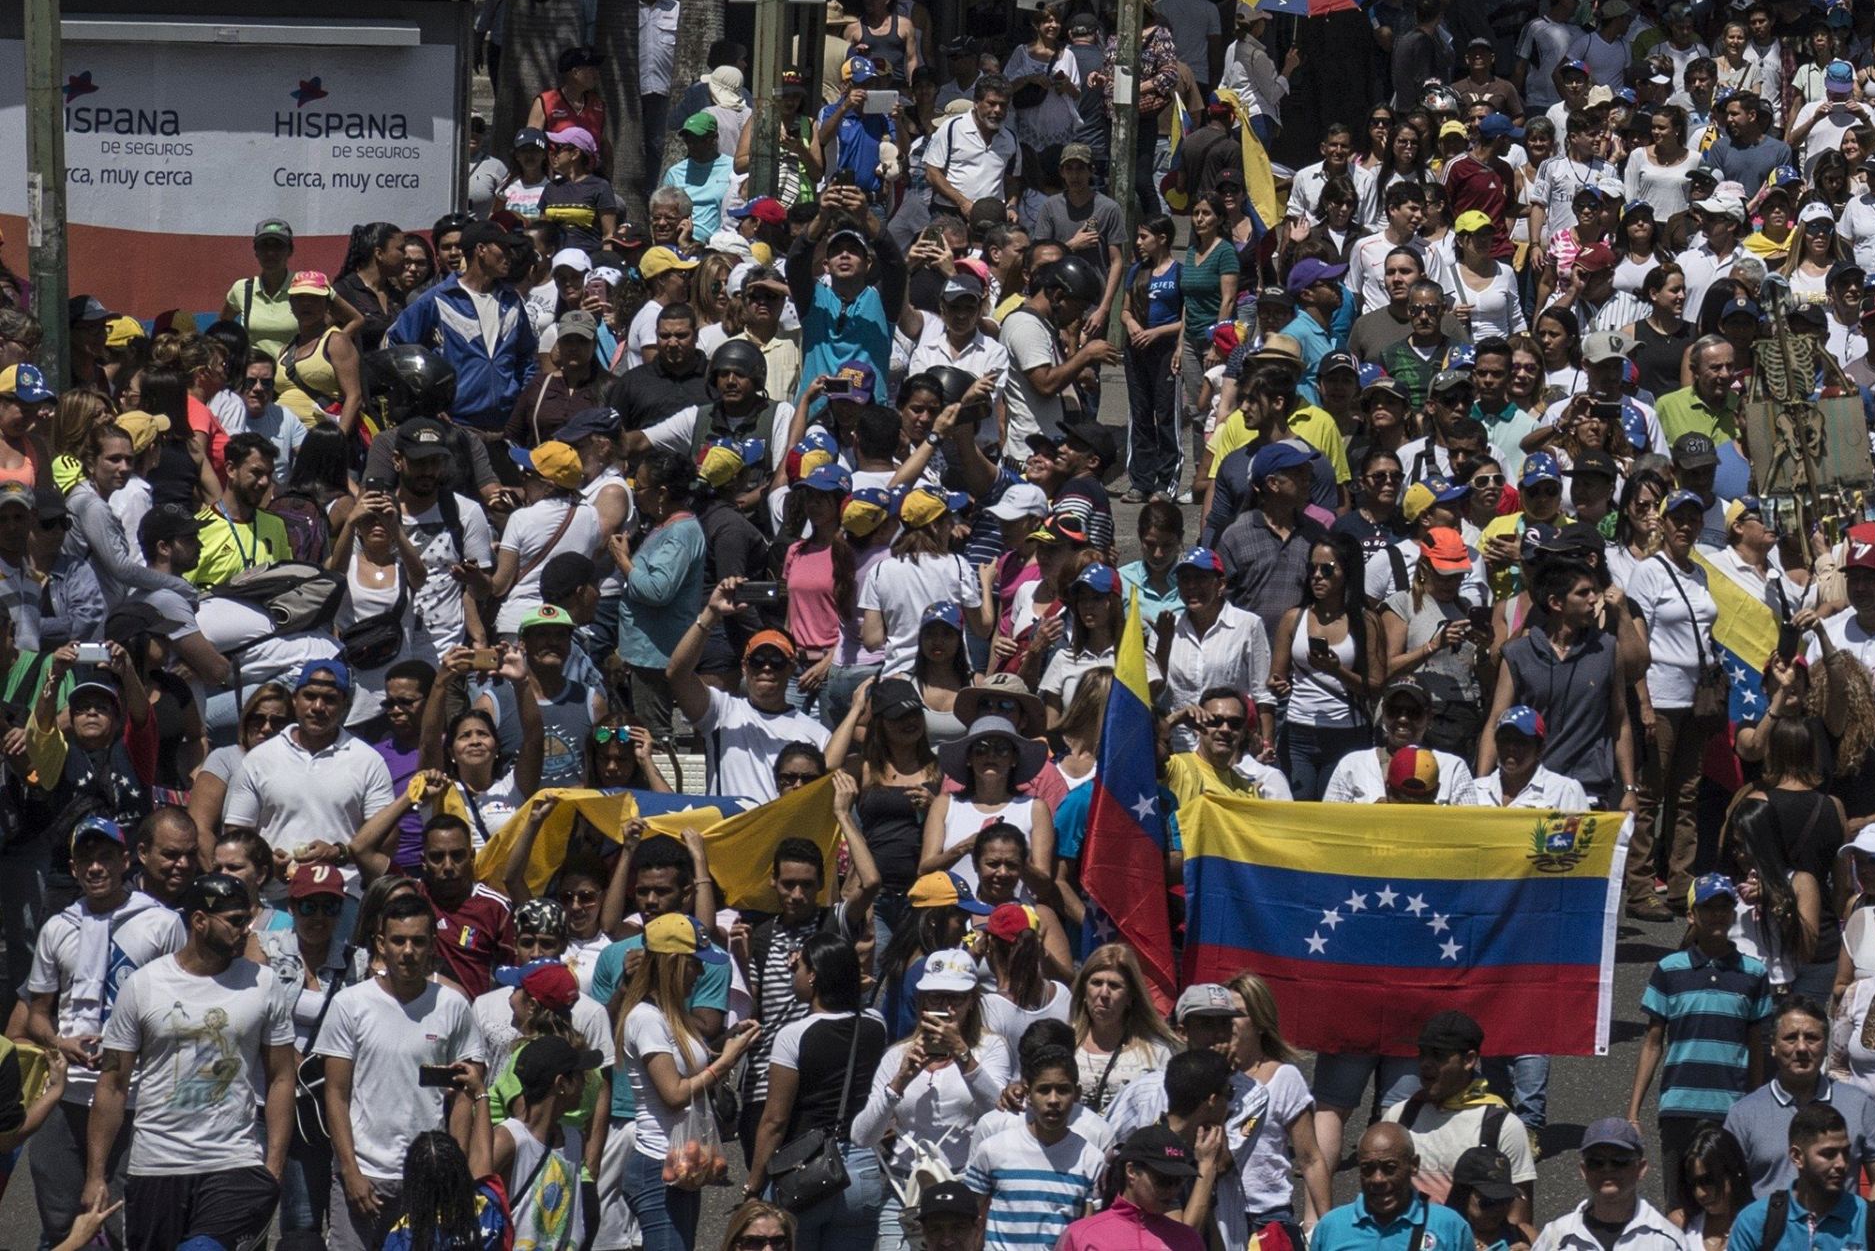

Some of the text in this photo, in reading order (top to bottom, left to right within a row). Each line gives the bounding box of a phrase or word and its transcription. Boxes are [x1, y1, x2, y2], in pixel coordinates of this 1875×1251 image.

[65, 168, 193, 189] rca, muy cerca
[273, 167, 419, 192] Cerca, muy cerca
